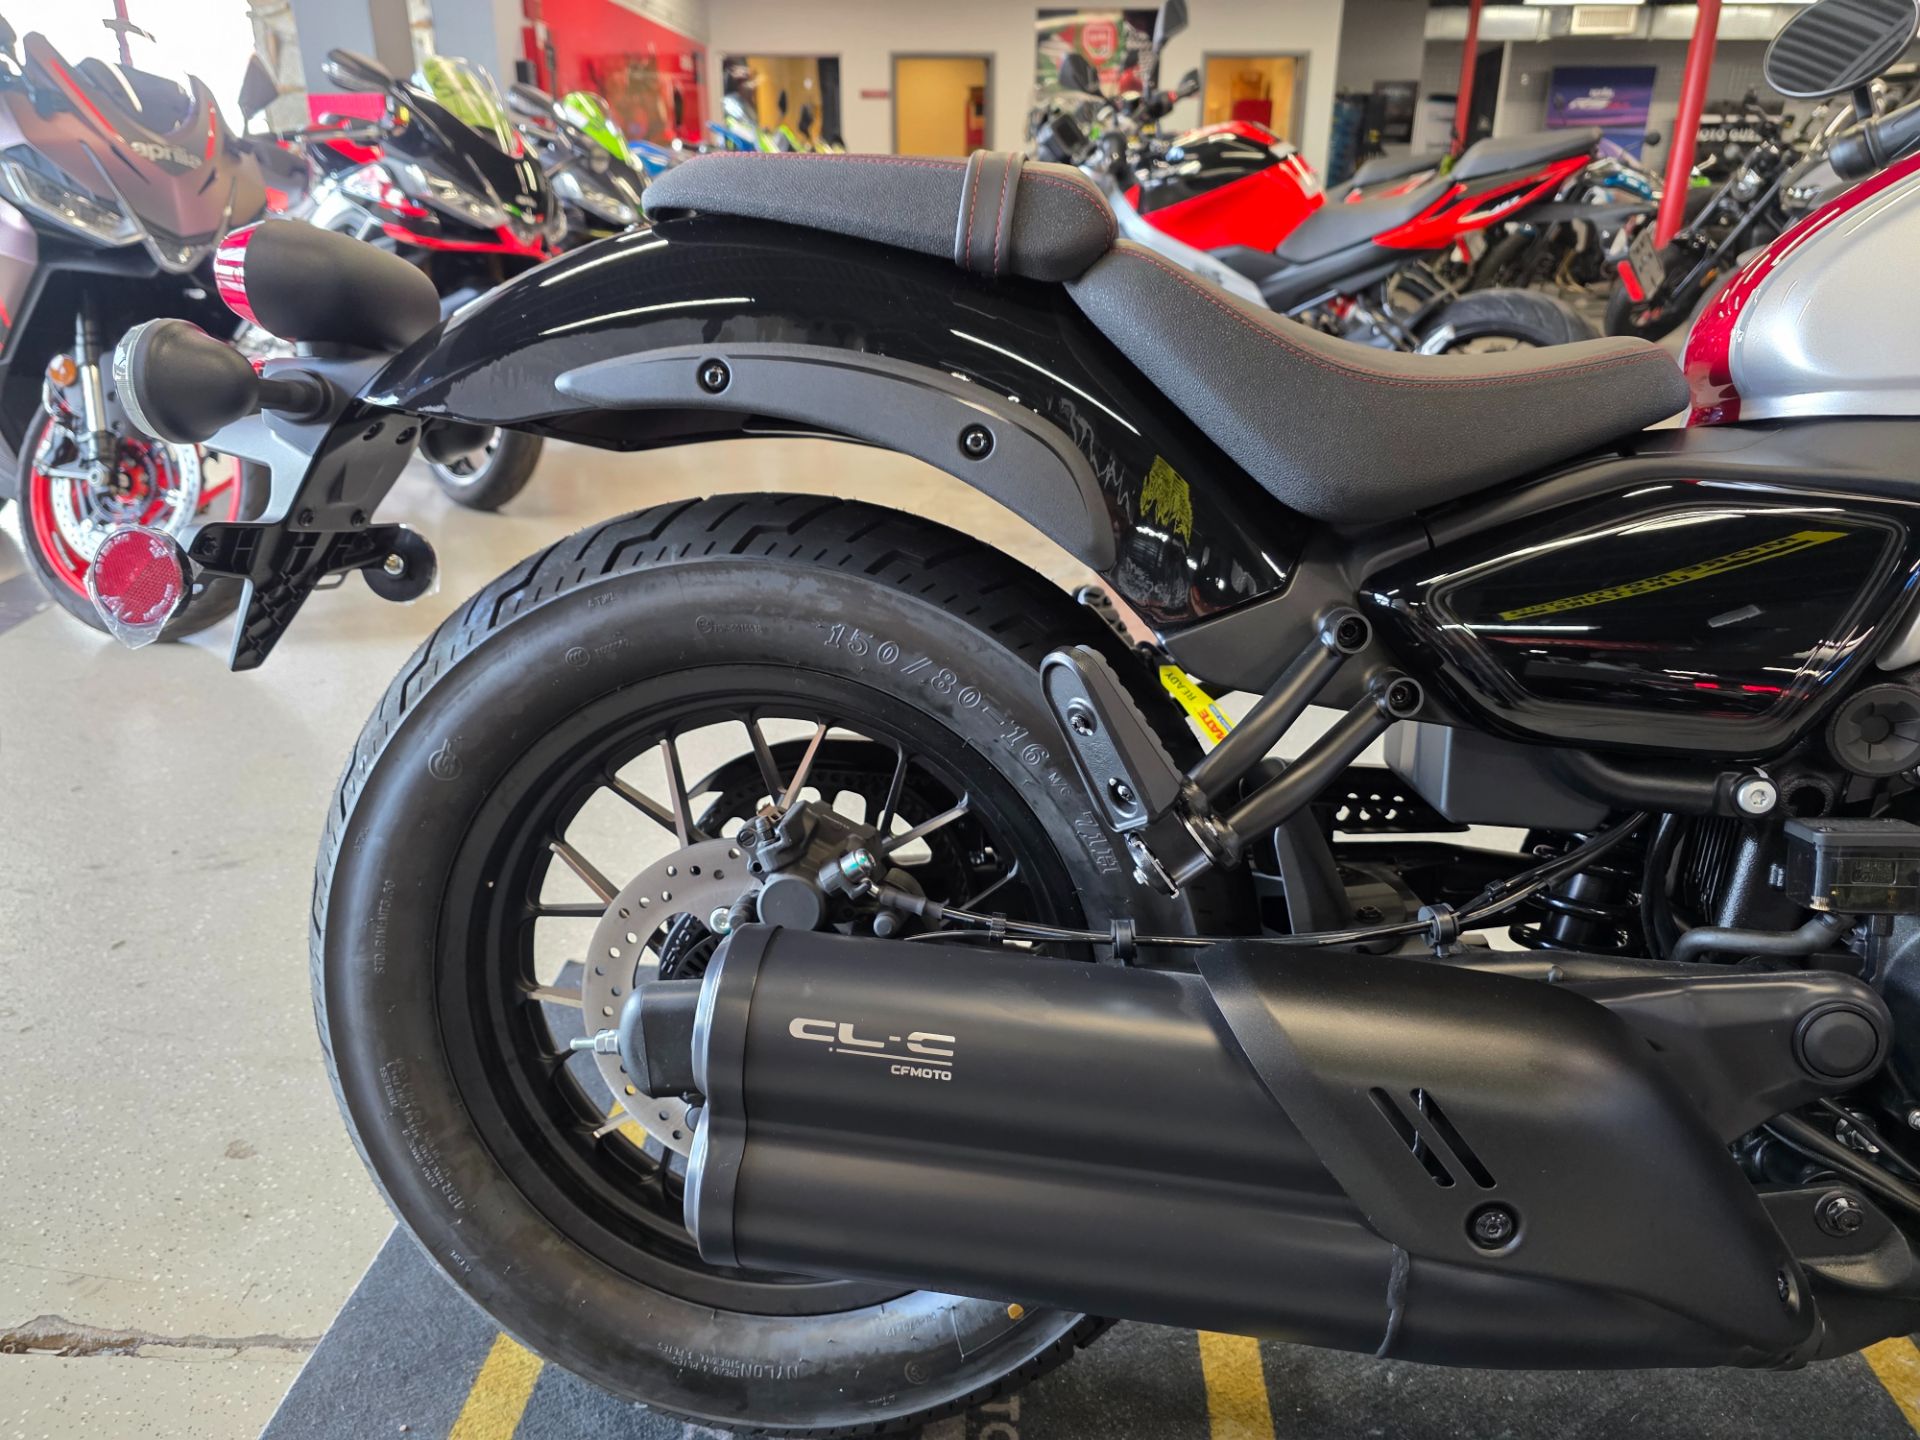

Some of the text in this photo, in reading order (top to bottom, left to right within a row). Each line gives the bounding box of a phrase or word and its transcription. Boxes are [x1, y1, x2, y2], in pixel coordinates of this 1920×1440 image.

[824, 623, 1049, 766] 150/80-16
[1165, 671, 1196, 701] READY
[789, 1017, 956, 1057] CL-C
[891, 1064, 952, 1081] CFMOTO
[740, 1364, 797, 1379] NYLON
